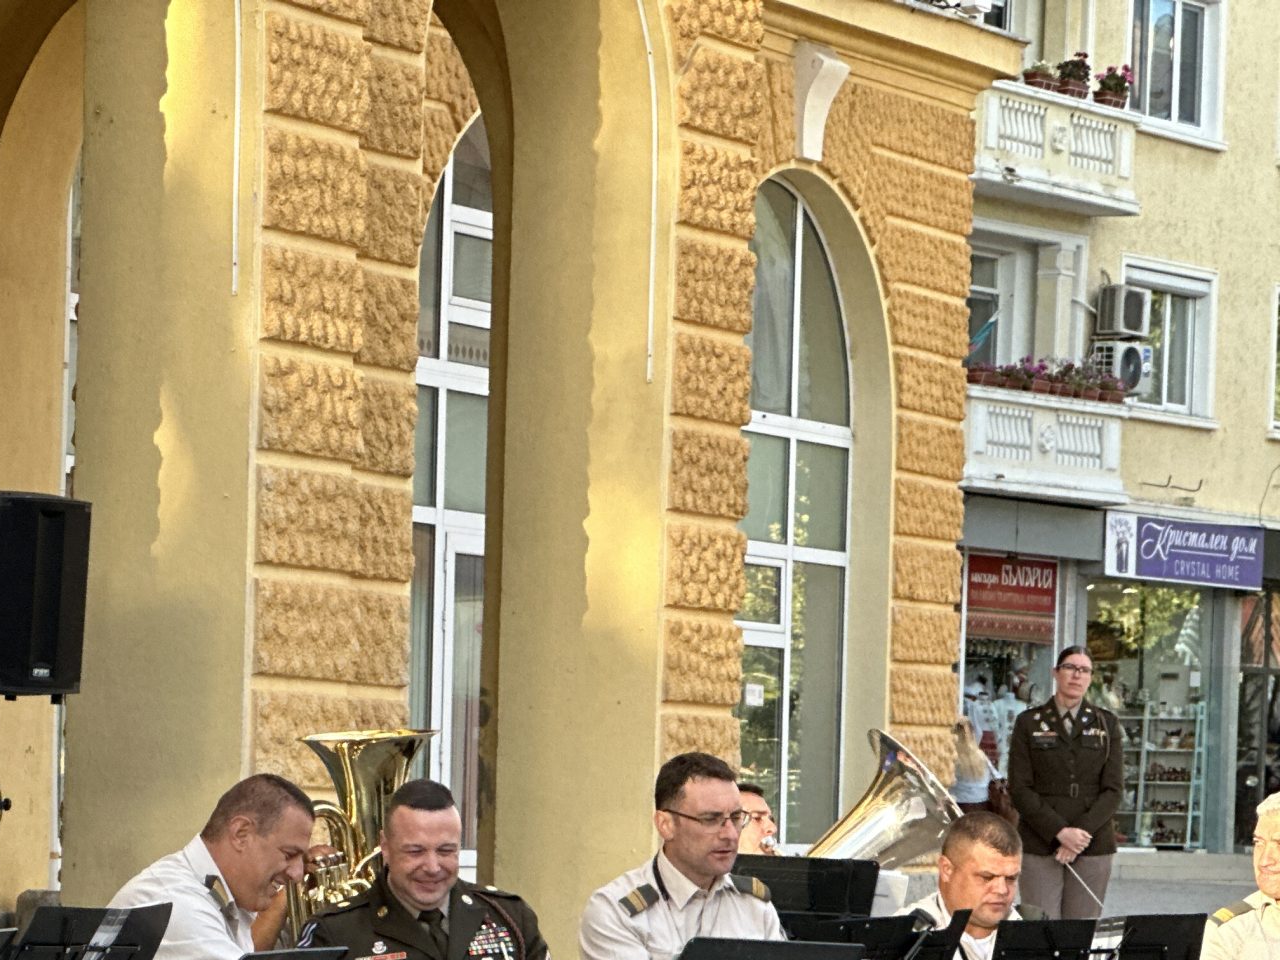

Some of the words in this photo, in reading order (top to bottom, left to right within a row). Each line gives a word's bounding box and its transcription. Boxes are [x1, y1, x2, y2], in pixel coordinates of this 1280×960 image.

[1140, 521, 1229, 561] Кристален
[1228, 536, 1258, 562] дом
[1174, 558, 1211, 579] CRYSTAL
[1215, 563, 1240, 581] HOME
